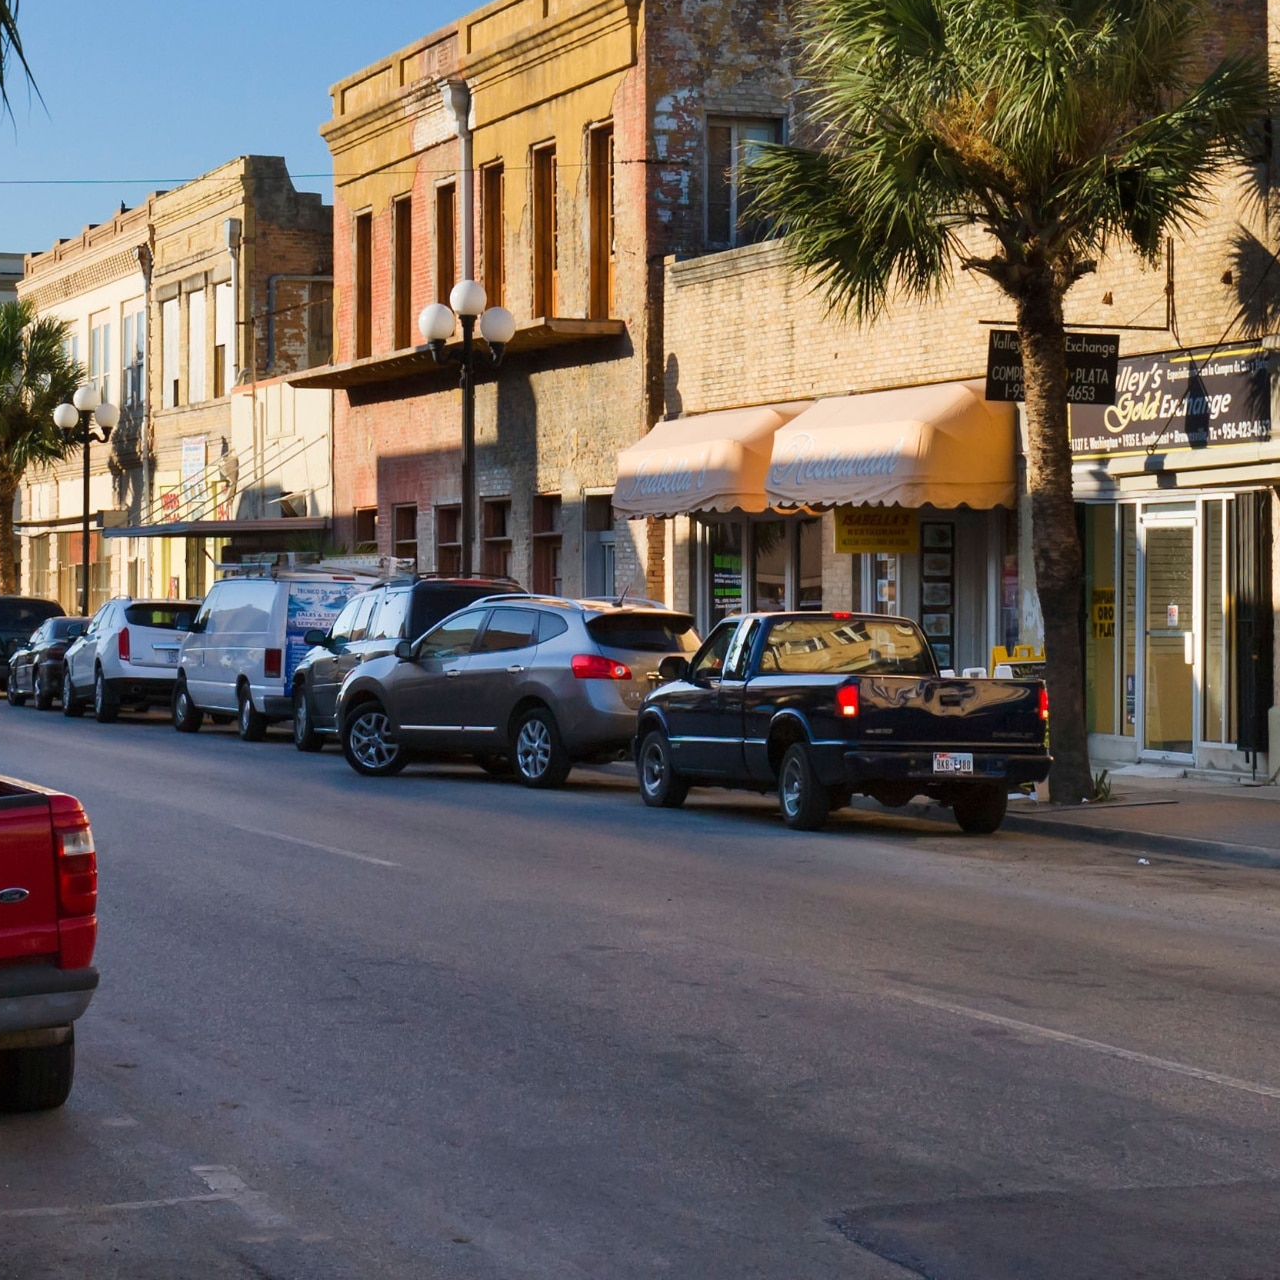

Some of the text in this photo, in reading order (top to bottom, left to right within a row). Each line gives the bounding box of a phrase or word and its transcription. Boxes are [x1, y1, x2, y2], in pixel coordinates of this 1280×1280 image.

[1065, 336, 1116, 358] Exchange
[1075, 368, 1109, 384] PLATA
[1214, 363, 1234, 377] Compra
[1234, 360, 1240, 373] de
[1066, 385, 1096, 401] 4653
[1104, 390, 1232, 433] Gold Exchange
[1089, 435, 1119, 452] Washington
[1122, 432, 1135, 448] 1935
[620, 433, 904, 502] Isabella's Restaurant
[841, 514, 911, 527] ISABELLA'S
[1098, 605, 1114, 621] ORO
